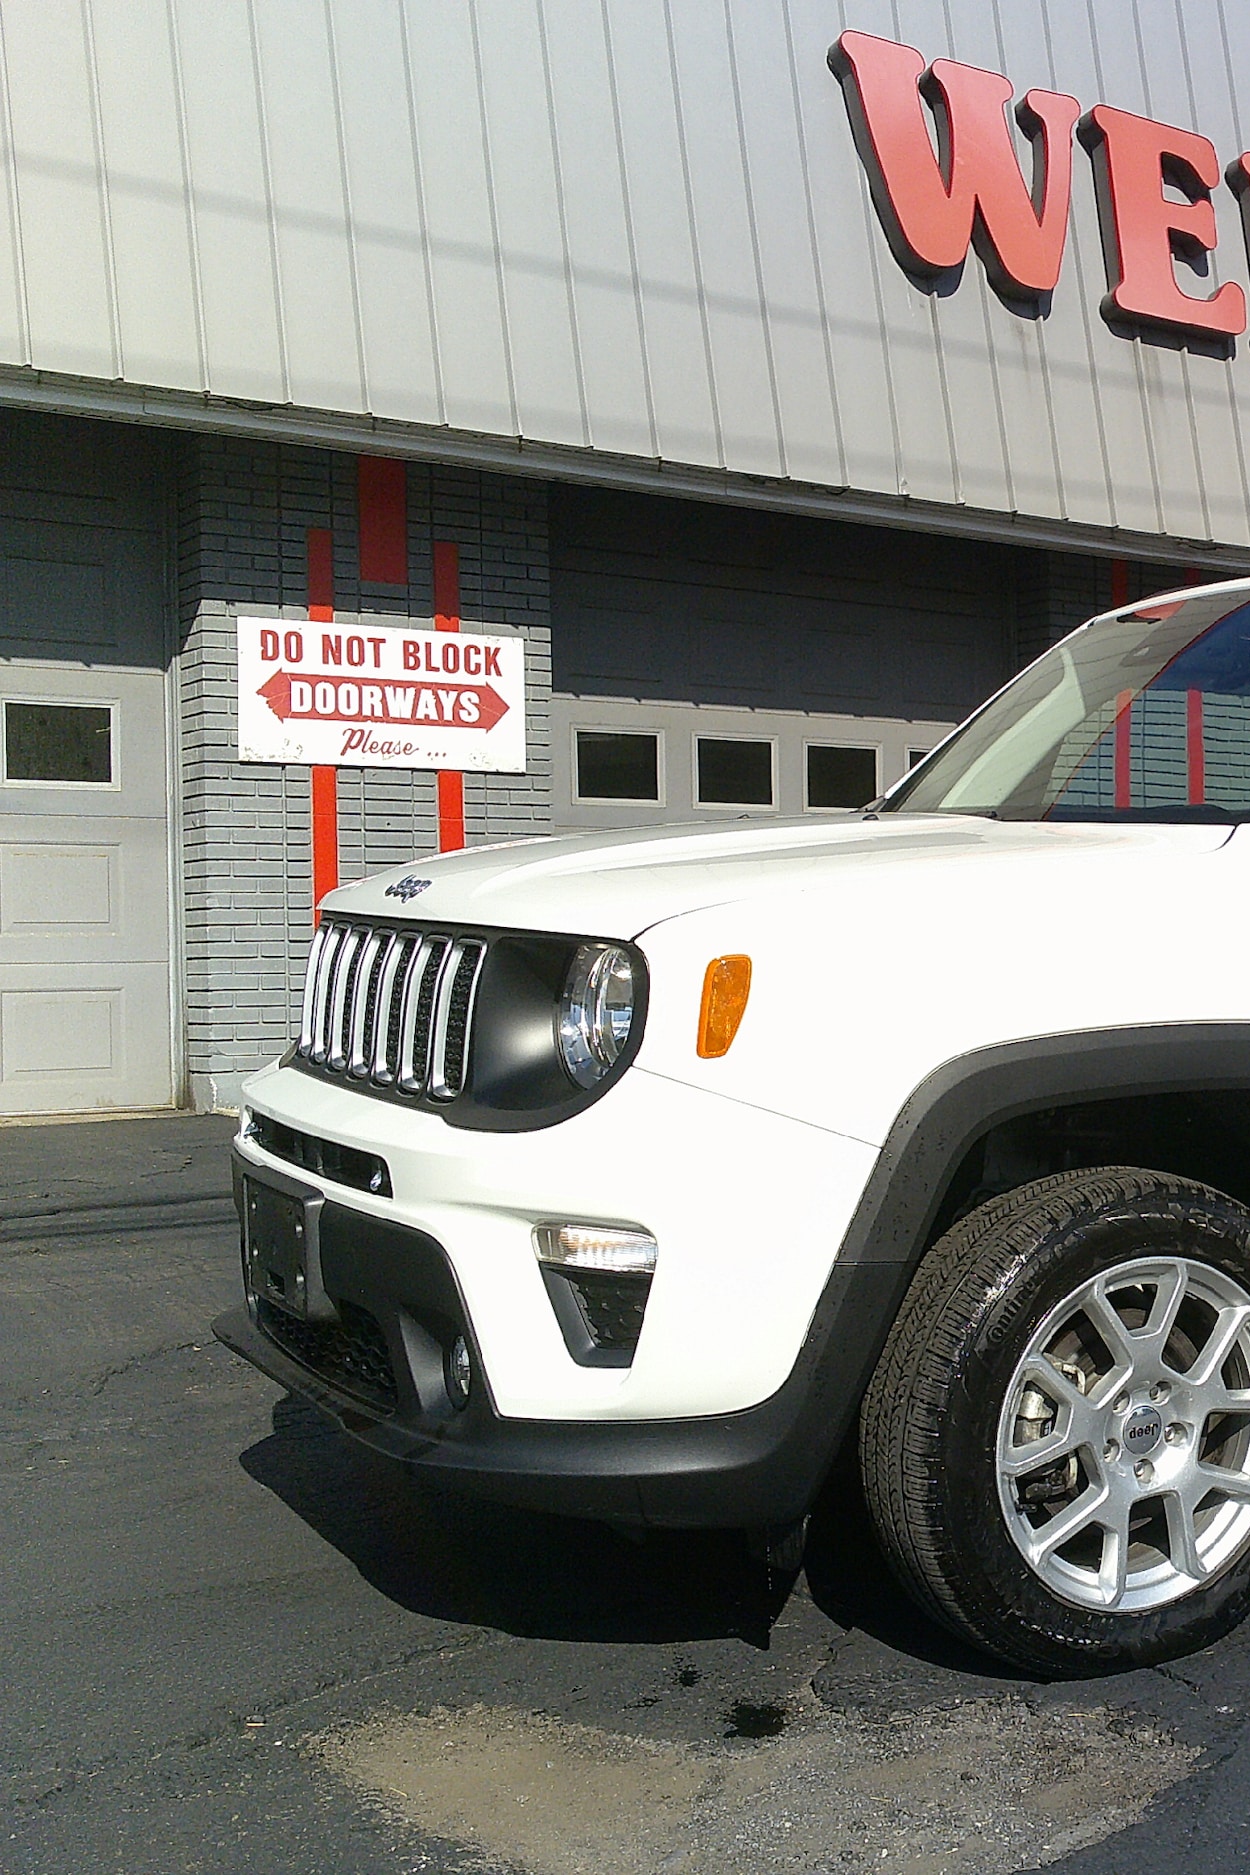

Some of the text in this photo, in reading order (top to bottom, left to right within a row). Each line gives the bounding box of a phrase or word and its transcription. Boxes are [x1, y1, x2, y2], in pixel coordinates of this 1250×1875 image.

[260, 629, 502, 677] DO NOT BLOCK
[290, 680, 480, 723] DOORWAYS
[340, 728, 419, 756] Please
